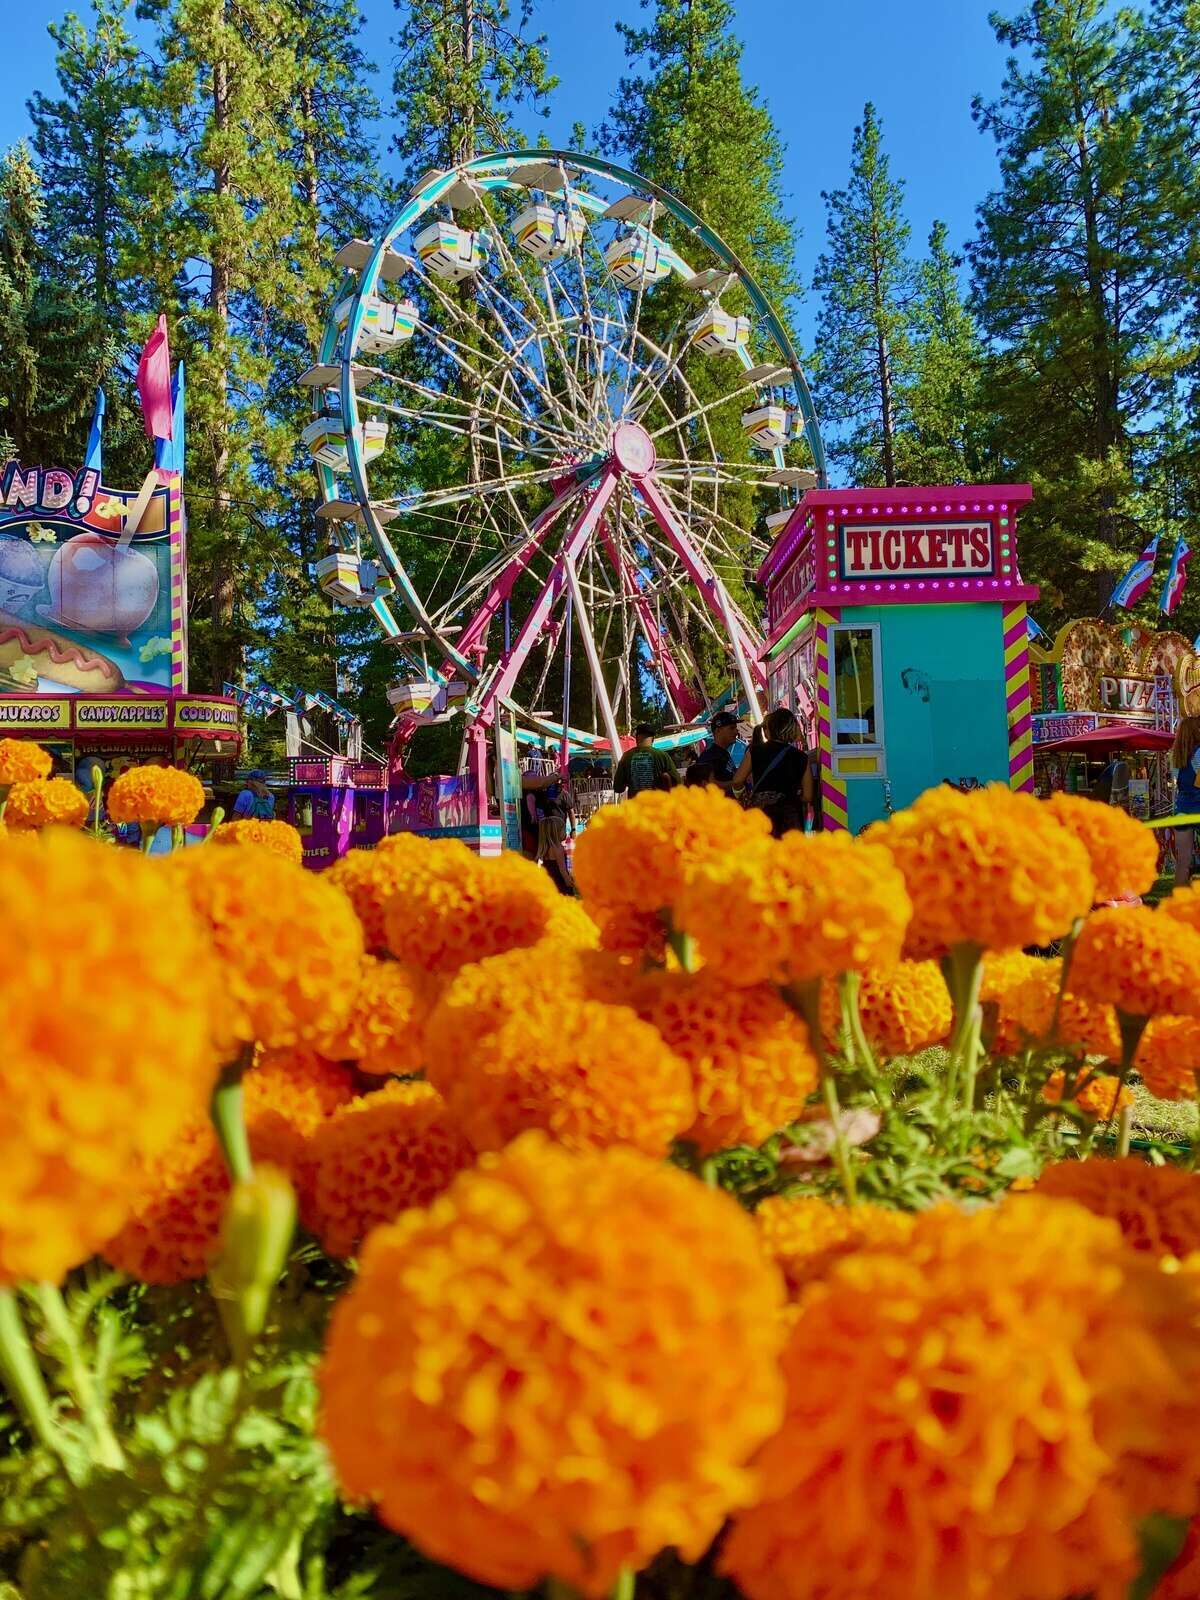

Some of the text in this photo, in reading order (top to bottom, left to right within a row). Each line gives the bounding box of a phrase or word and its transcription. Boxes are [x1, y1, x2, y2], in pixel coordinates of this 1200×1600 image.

[0, 465, 98, 515] ND!
[846, 527, 991, 571] TICKETS
[1100, 676, 1165, 709] PIZZ
[79, 705, 165, 722] CANDY APPLES
[1039, 725, 1089, 738] DRINKS
